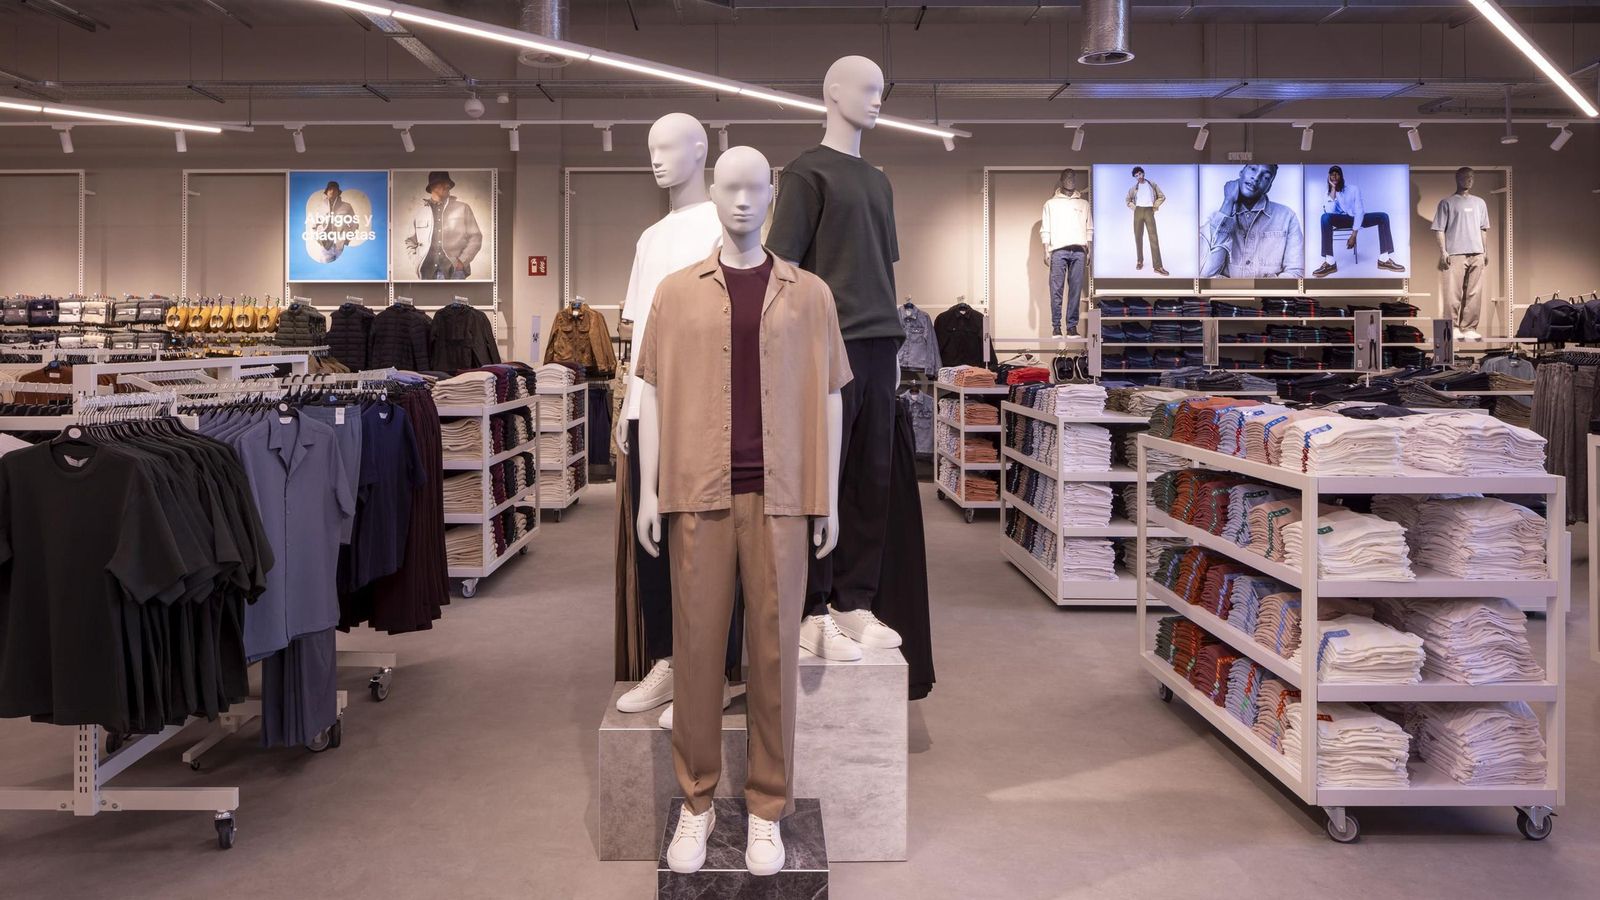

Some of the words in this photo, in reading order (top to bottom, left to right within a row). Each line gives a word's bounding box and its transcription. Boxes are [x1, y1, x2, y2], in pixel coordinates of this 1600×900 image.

[304, 211, 360, 227] Abrigos
[364, 215, 373, 227] y
[301, 229, 377, 244] chaquetas
